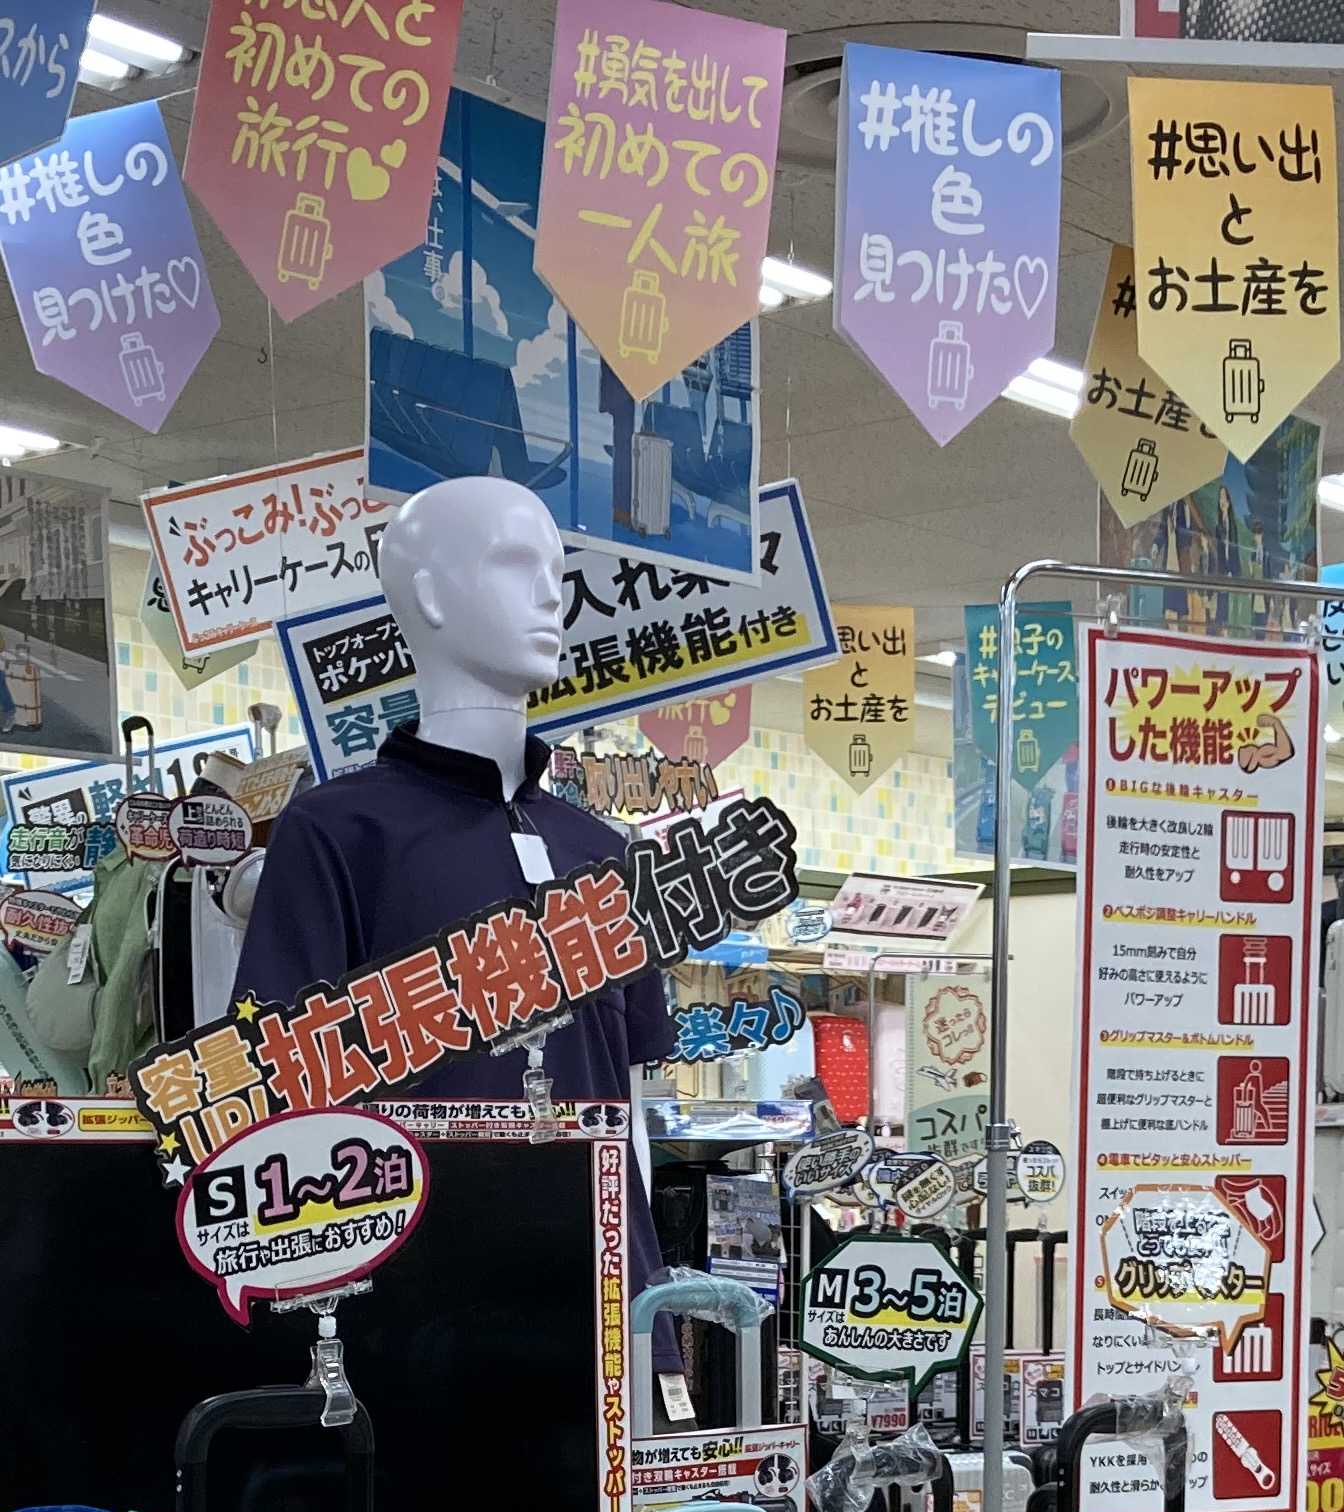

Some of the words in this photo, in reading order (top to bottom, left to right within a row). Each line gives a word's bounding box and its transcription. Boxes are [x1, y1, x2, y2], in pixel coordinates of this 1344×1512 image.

[226, 11, 430, 126] 初めての
[574, 28, 768, 129] #勇気を出して
[231, 95, 349, 190] 旅行
[860, 79, 1053, 166] #推しの
[1149, 120, 1322, 182] #思い出
[0, 141, 170, 225] #推しの
[555, 103, 768, 207] 初めての
[932, 165, 985, 235] 色
[1221, 195, 1256, 245] と
[80, 211, 133, 267] 色
[578, 202, 742, 286] 一人旅
[1147, 257, 1328, 316] お土産を
[851, 661, 869, 687] と
[1104, 666, 1304, 713] パワーアップ
[811, 693, 908, 722] お土産を
[1106, 717, 1235, 766] した機能
[257, 805, 801, 1111] 拡張機能付き
[1124, 992, 1184, 1008] パワーアップ
[136, 1020, 260, 1119] 容量
[916, 1103, 987, 1140] コスパ
[196, 1221, 250, 1246] サイズは
[215, 1211, 407, 1275] 旅行や出張におすすめ!
[808, 1309, 846, 1324] サイズは
[820, 1274, 843, 1304] M
[824, 1326, 952, 1352] あんしんの大きさです
